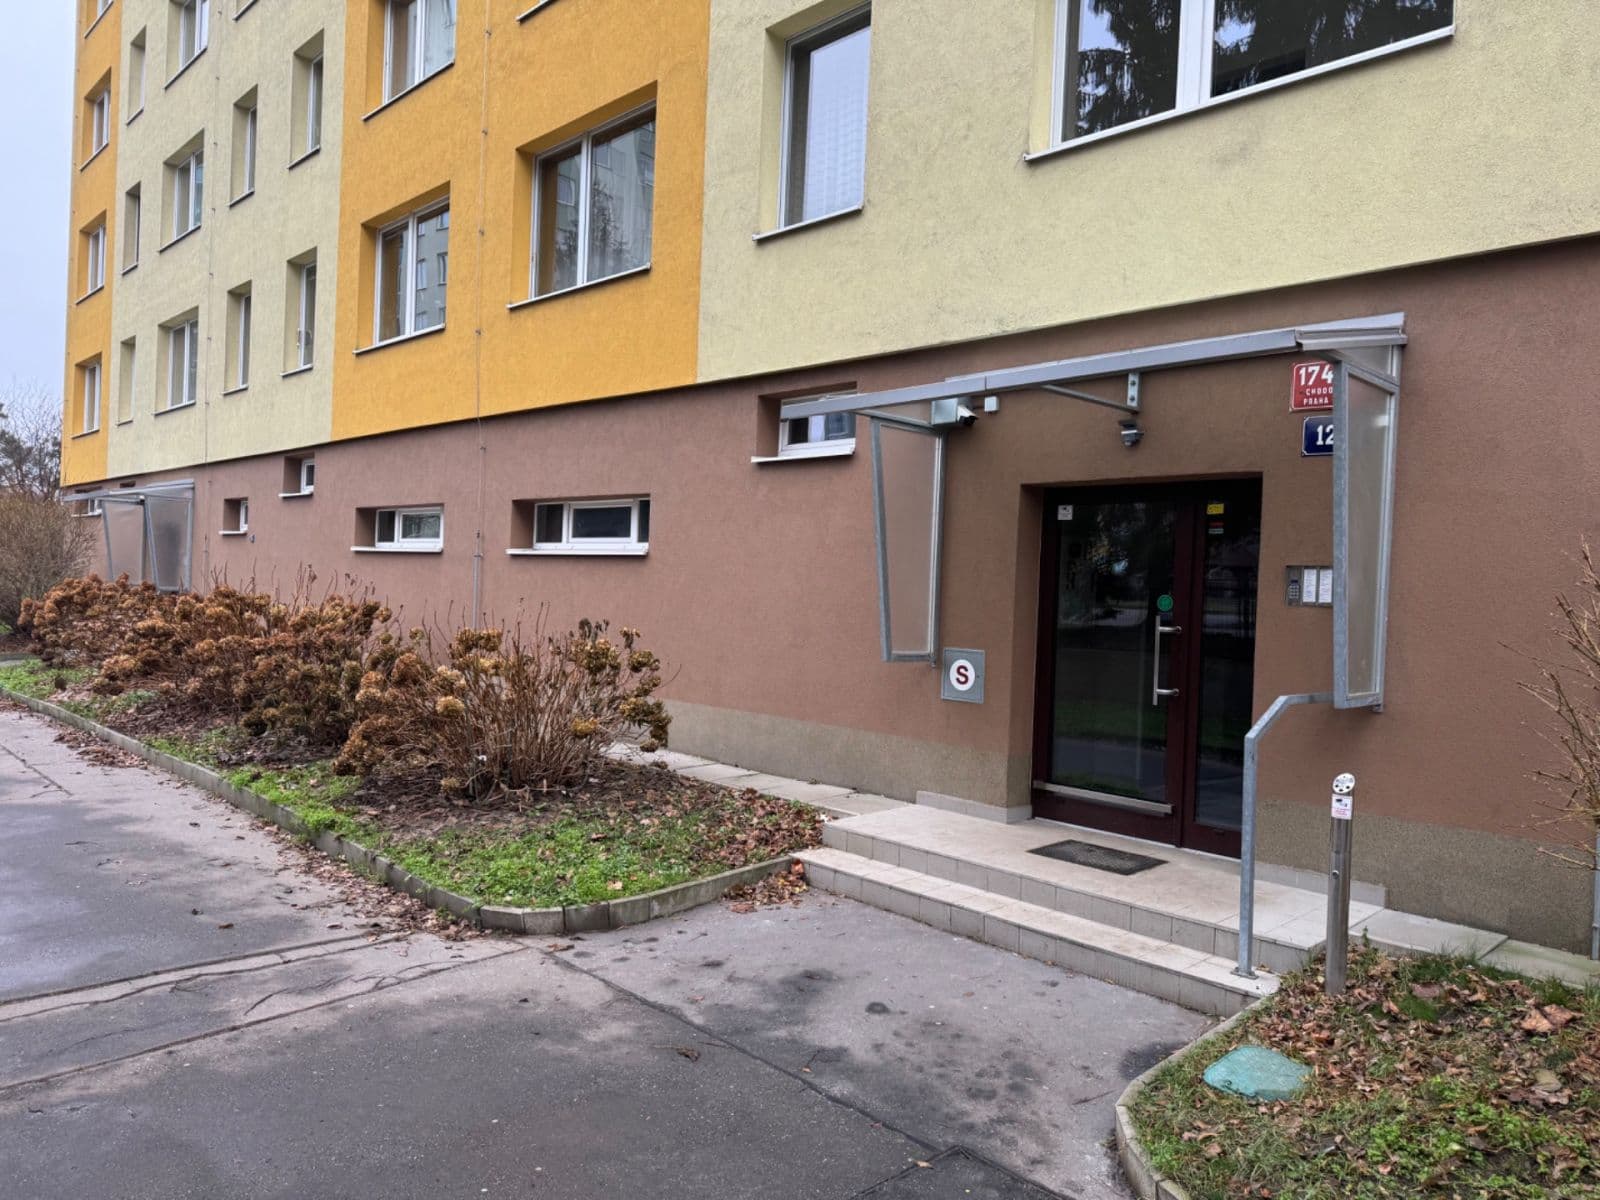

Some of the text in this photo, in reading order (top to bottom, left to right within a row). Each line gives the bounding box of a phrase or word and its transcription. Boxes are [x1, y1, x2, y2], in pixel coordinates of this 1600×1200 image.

[1299, 364, 1333, 386] 174
[1303, 397, 1329, 406] PRAHA
[1305, 387, 1333, 396] CHODO
[1316, 424, 1334, 446] 12
[956, 664, 969, 685] S
